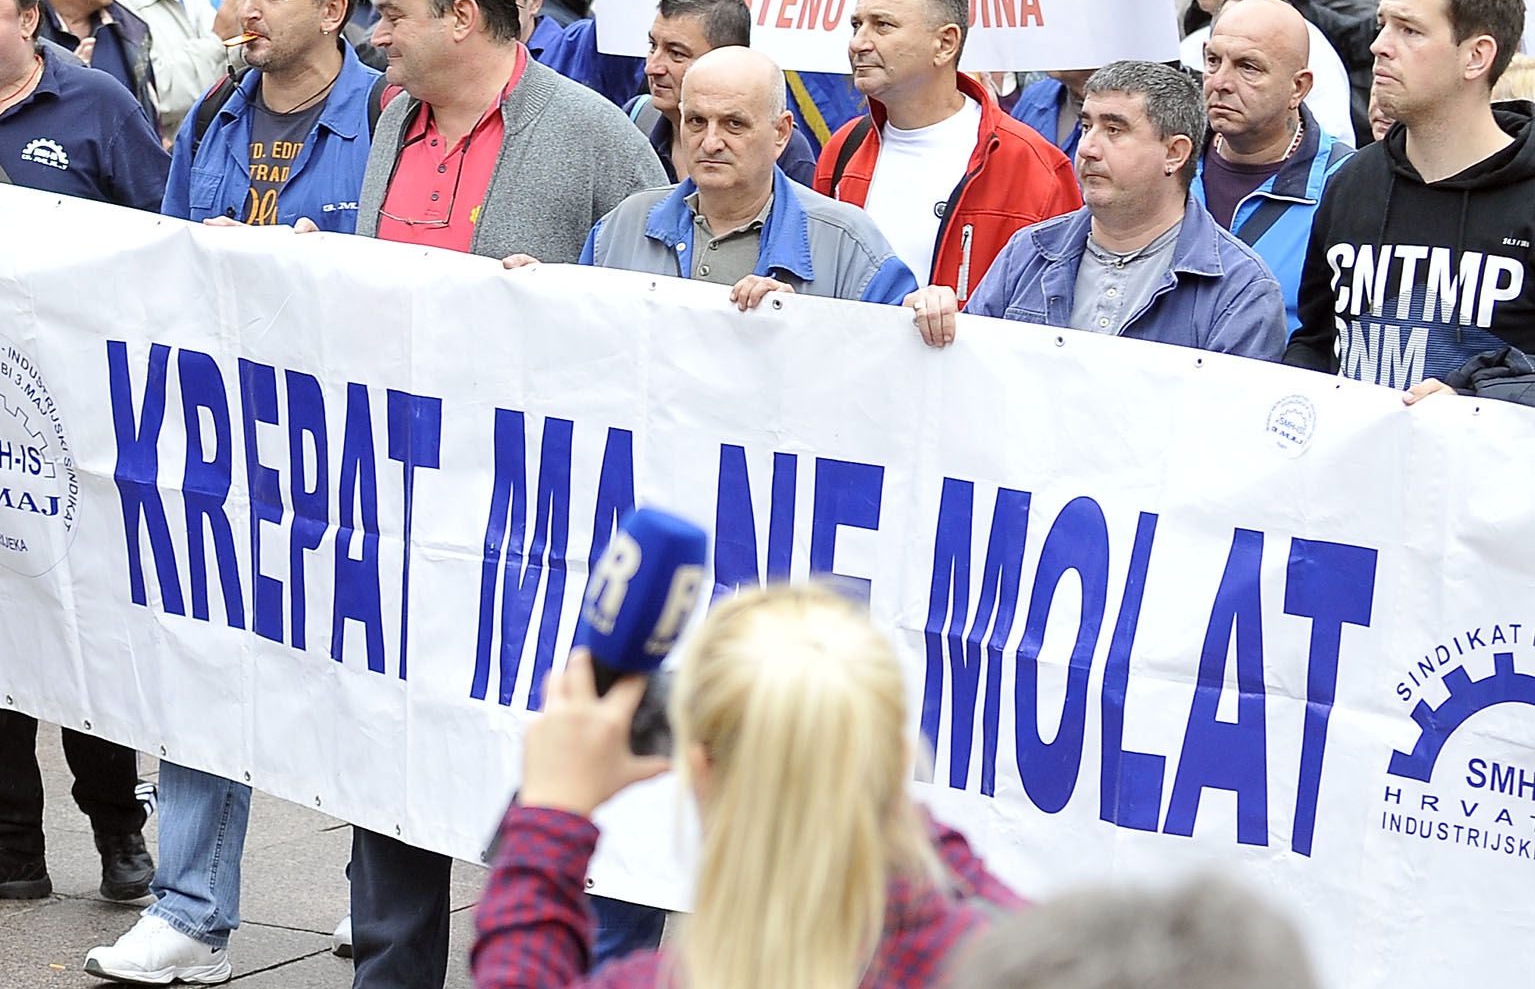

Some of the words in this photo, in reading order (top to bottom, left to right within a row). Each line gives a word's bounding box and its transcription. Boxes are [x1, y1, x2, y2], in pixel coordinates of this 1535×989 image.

[1, 362, 13, 379] BI
[14, 373, 49, 416] 3.MAJ
[63, 457, 79, 533] SINDIKAT
[106, 340, 443, 681] KREPAT
[918, 476, 1379, 859] MOLAT
[1396, 624, 1522, 702] SINDIKAT
